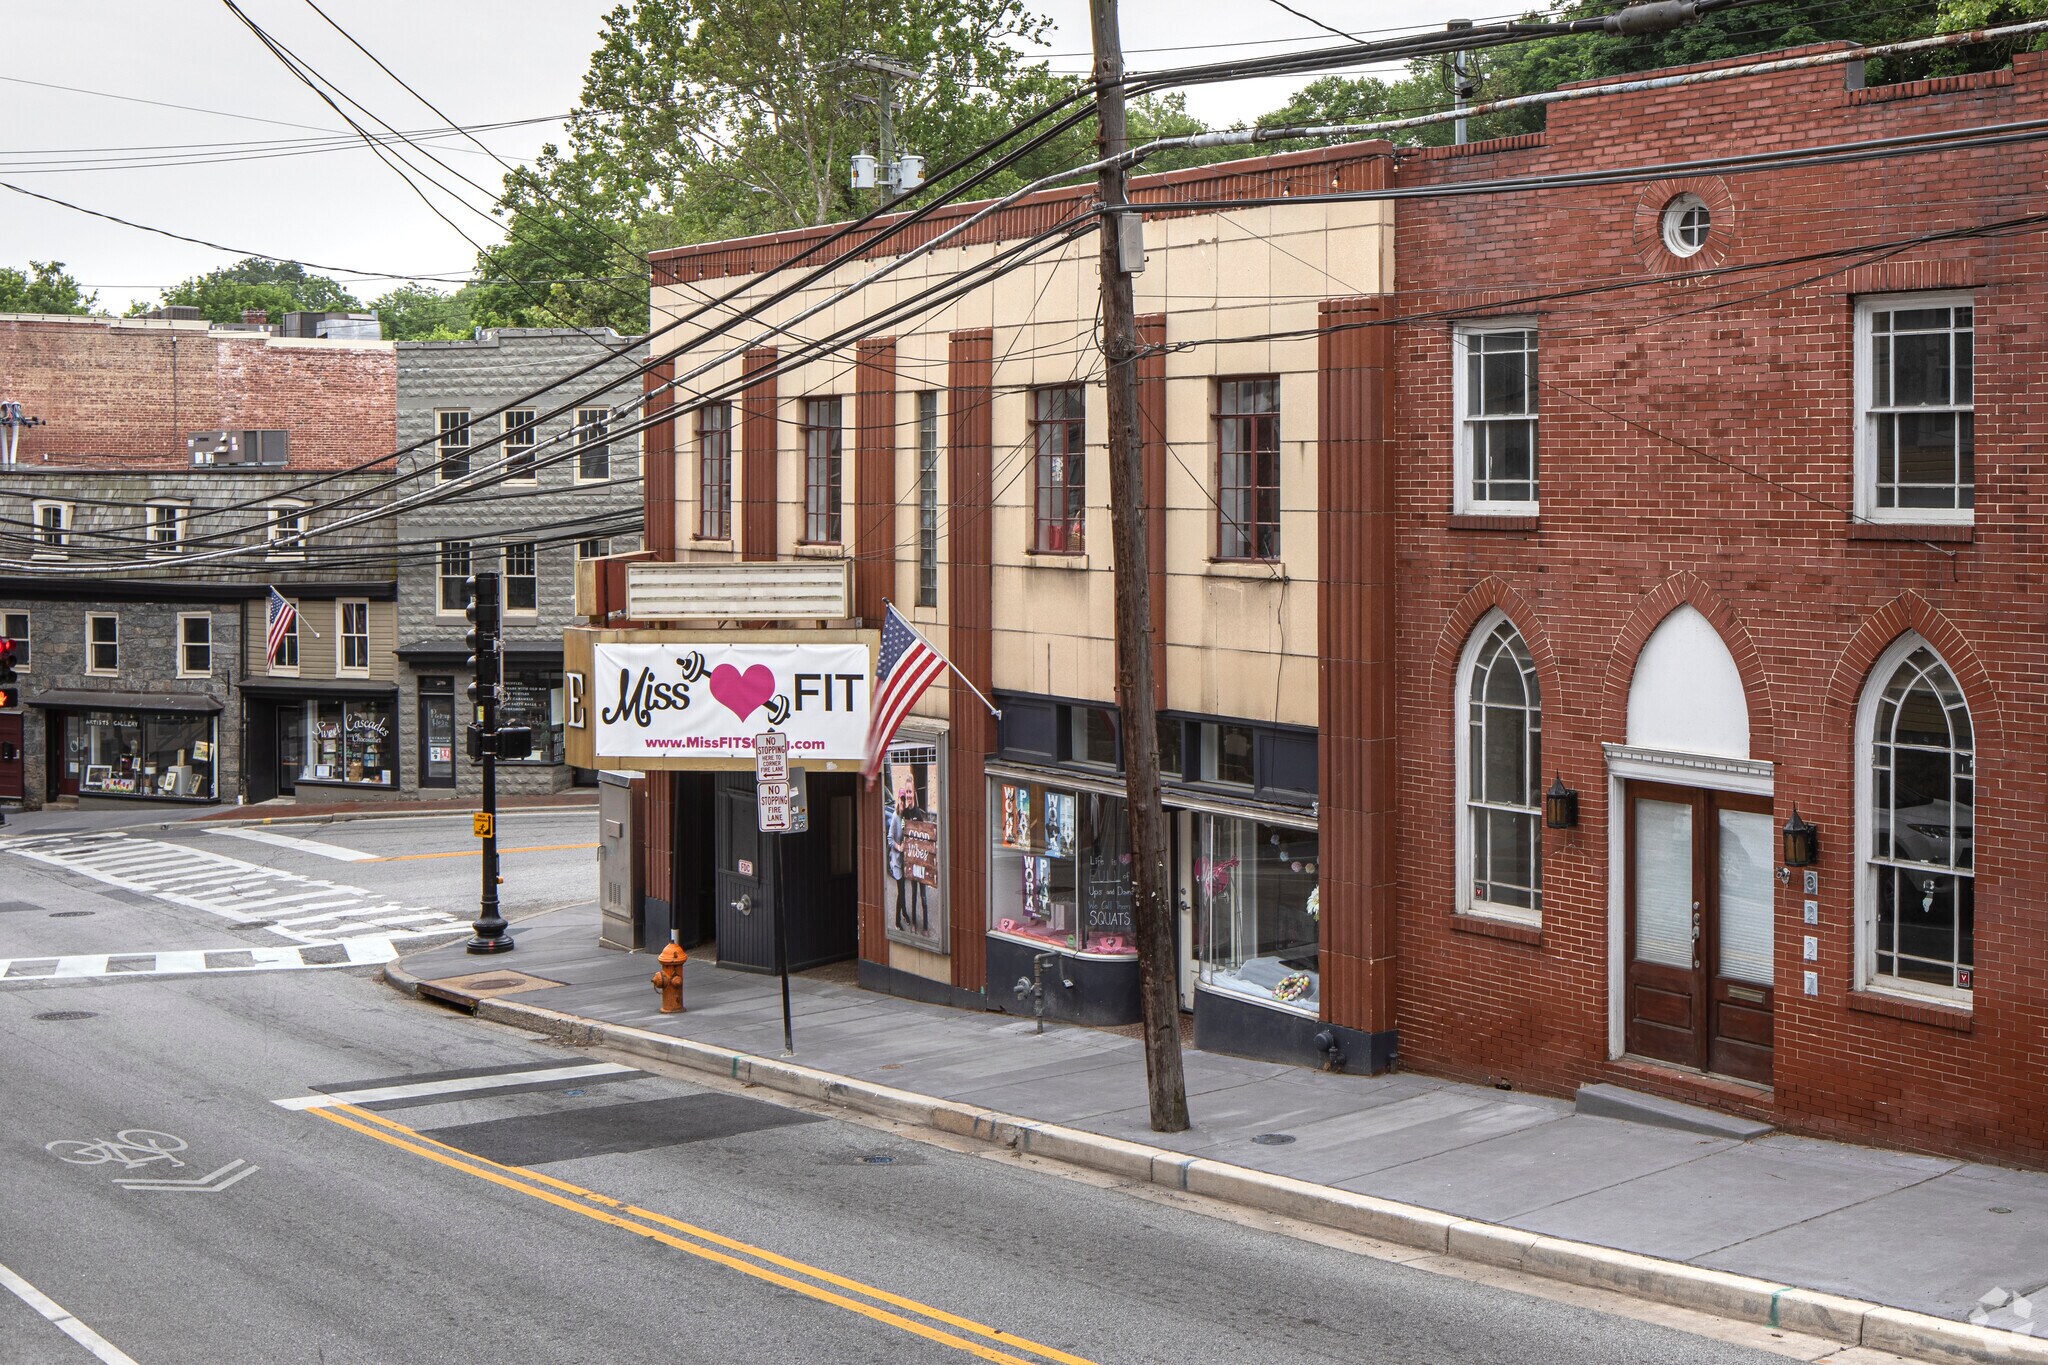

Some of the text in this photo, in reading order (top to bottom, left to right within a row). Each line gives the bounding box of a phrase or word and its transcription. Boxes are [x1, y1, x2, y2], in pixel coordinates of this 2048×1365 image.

[566, 673, 585, 729] E
[601, 666, 864, 727] Miss FIT
[312, 714, 389, 738] Sweet Cascades
[645, 736, 825, 751] www.MissFITSt.com
[766, 737, 776, 746] NO
[758, 746, 785, 755] STOPPING
[768, 786, 780, 795] NO
[761, 796, 788, 806] STOPPING
[1020, 789, 1028, 841] PLAY
[740, 862, 750, 872] FDC
[1090, 855, 1104, 867] Life
[1024, 855, 1034, 907] WORK
[1090, 868, 1130, 882] FULL of
[1088, 886, 1102, 898] Ups
[1088, 900, 1098, 910] We
[1101, 900, 1112, 910] Call
